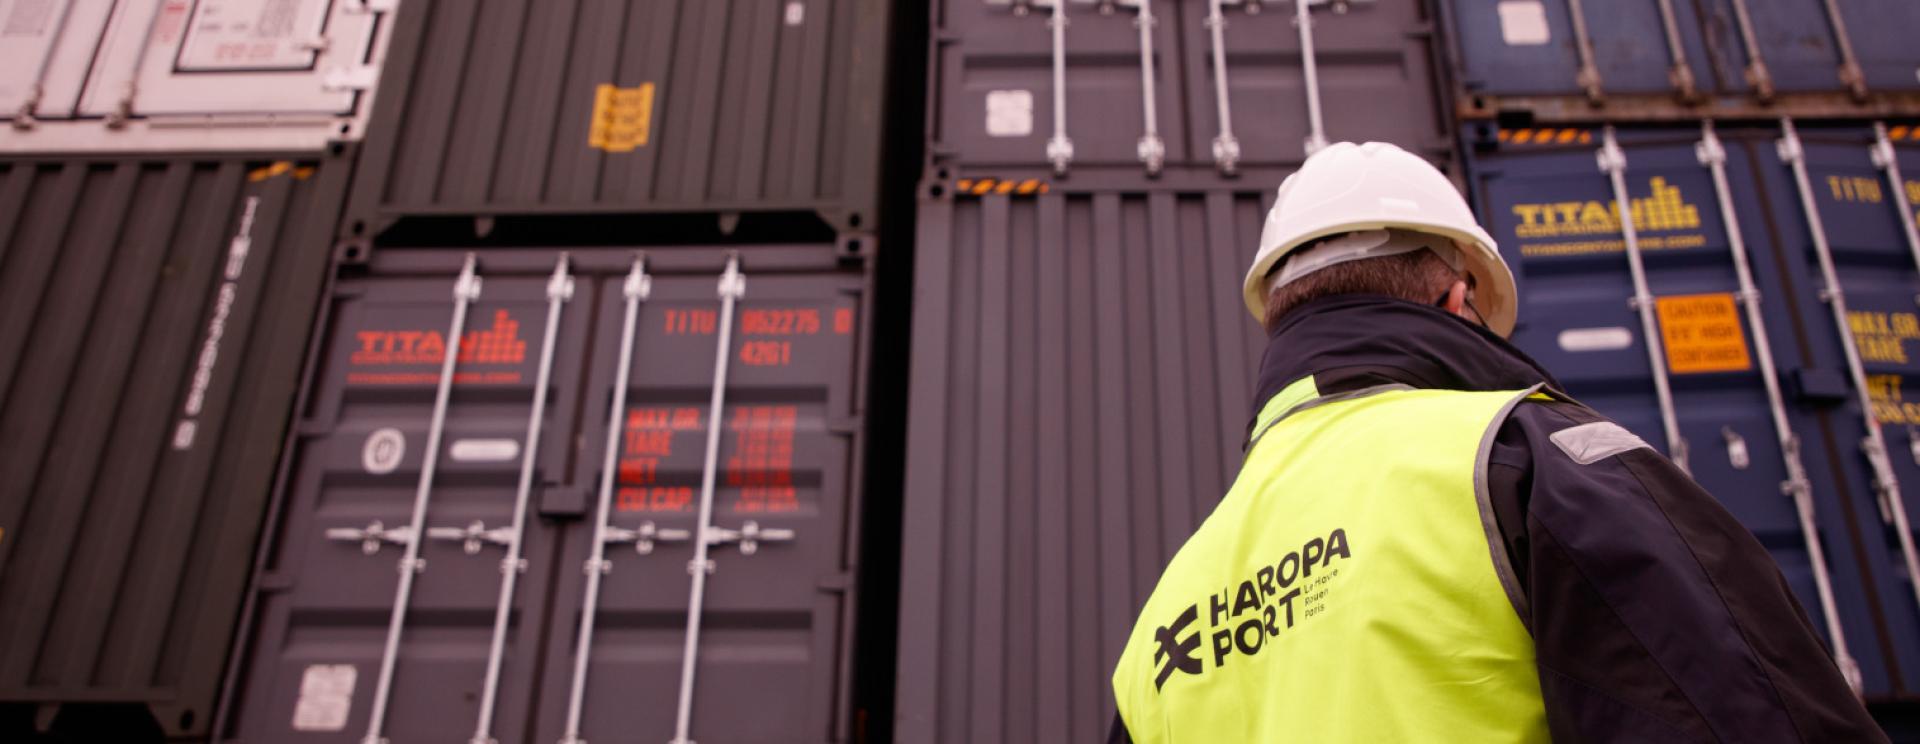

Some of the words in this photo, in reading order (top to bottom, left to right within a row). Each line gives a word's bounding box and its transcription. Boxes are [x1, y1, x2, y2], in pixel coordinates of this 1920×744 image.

[1210, 528, 1351, 628] HAROPA
[1314, 569, 1338, 587] Havre
[1304, 588, 1329, 607] Rouen
[1304, 602, 1325, 620] Paris
[1212, 587, 1301, 668] PORT
